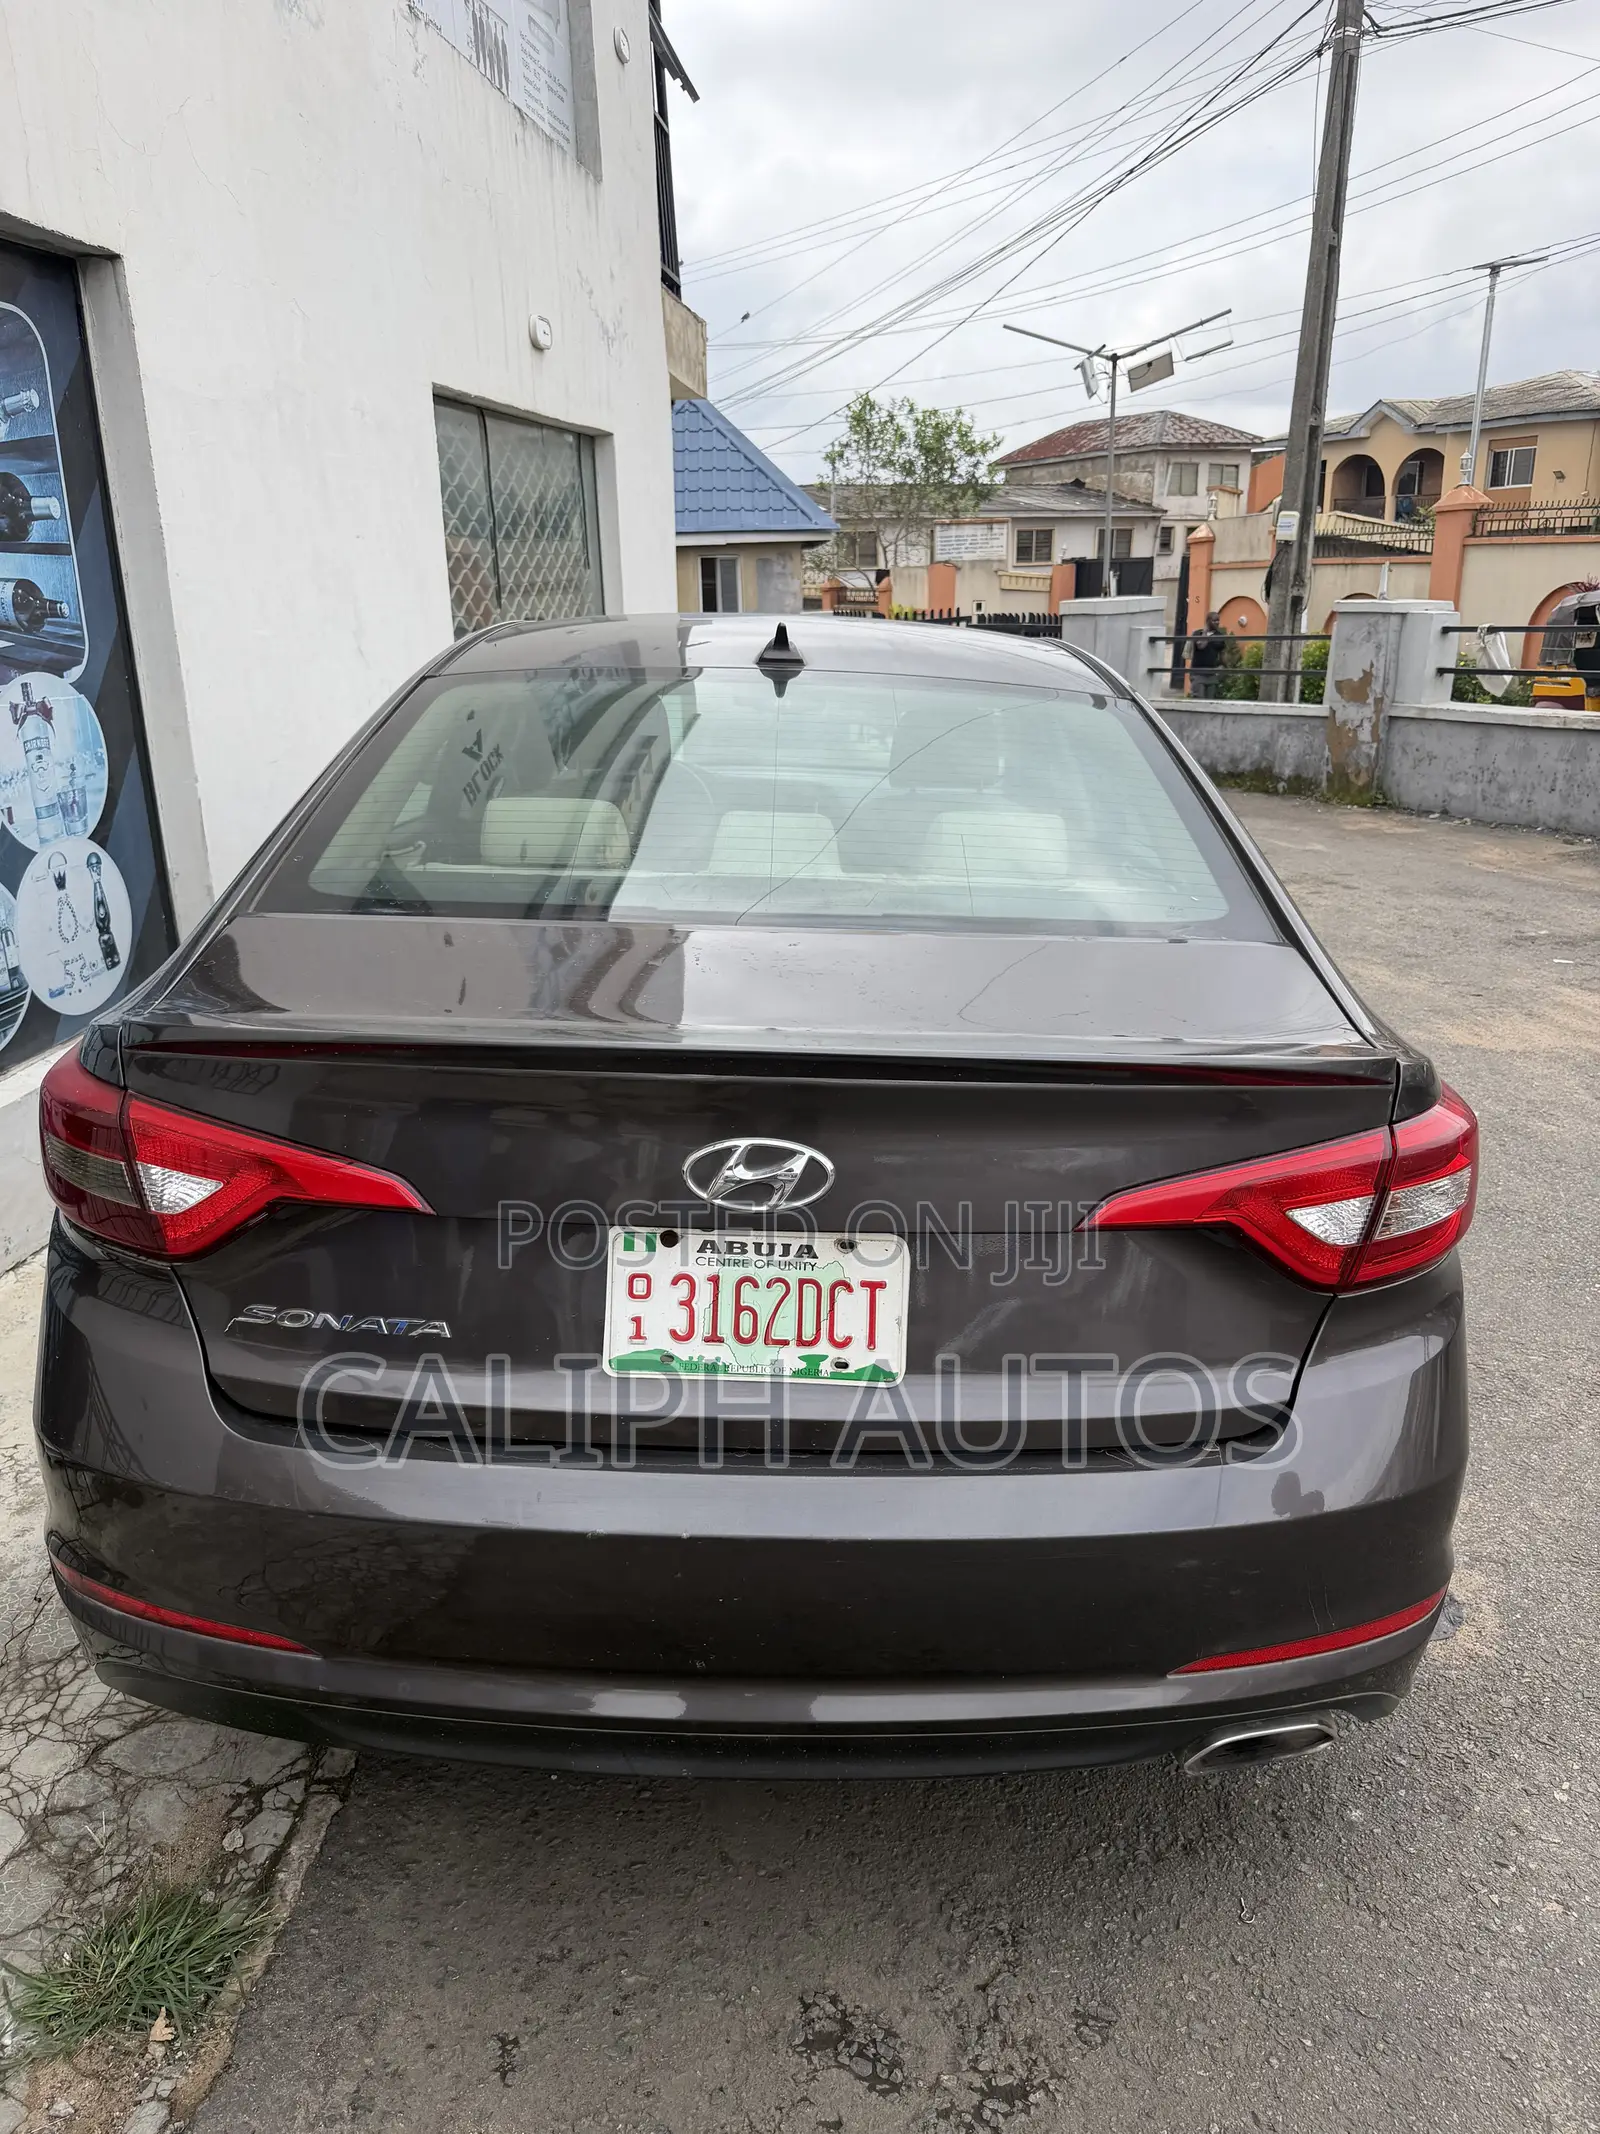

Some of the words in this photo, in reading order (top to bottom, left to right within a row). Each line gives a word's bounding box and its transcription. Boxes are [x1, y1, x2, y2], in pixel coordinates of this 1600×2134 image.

[696, 1239, 819, 1259] ABUJA
[695, 1256, 750, 1268] CENTRE
[753, 1258, 774, 1269] OF
[778, 1259, 817, 1271] UNITY
[224, 1303, 452, 1338] SONATA
[669, 1273, 888, 1351] 3162DCT
[679, 1362, 723, 1372] FEDERAL
[724, 1362, 771, 1374] REPUBLIC
[773, 1366, 787, 1375] OF
[789, 1367, 830, 1377] NIGERIA
